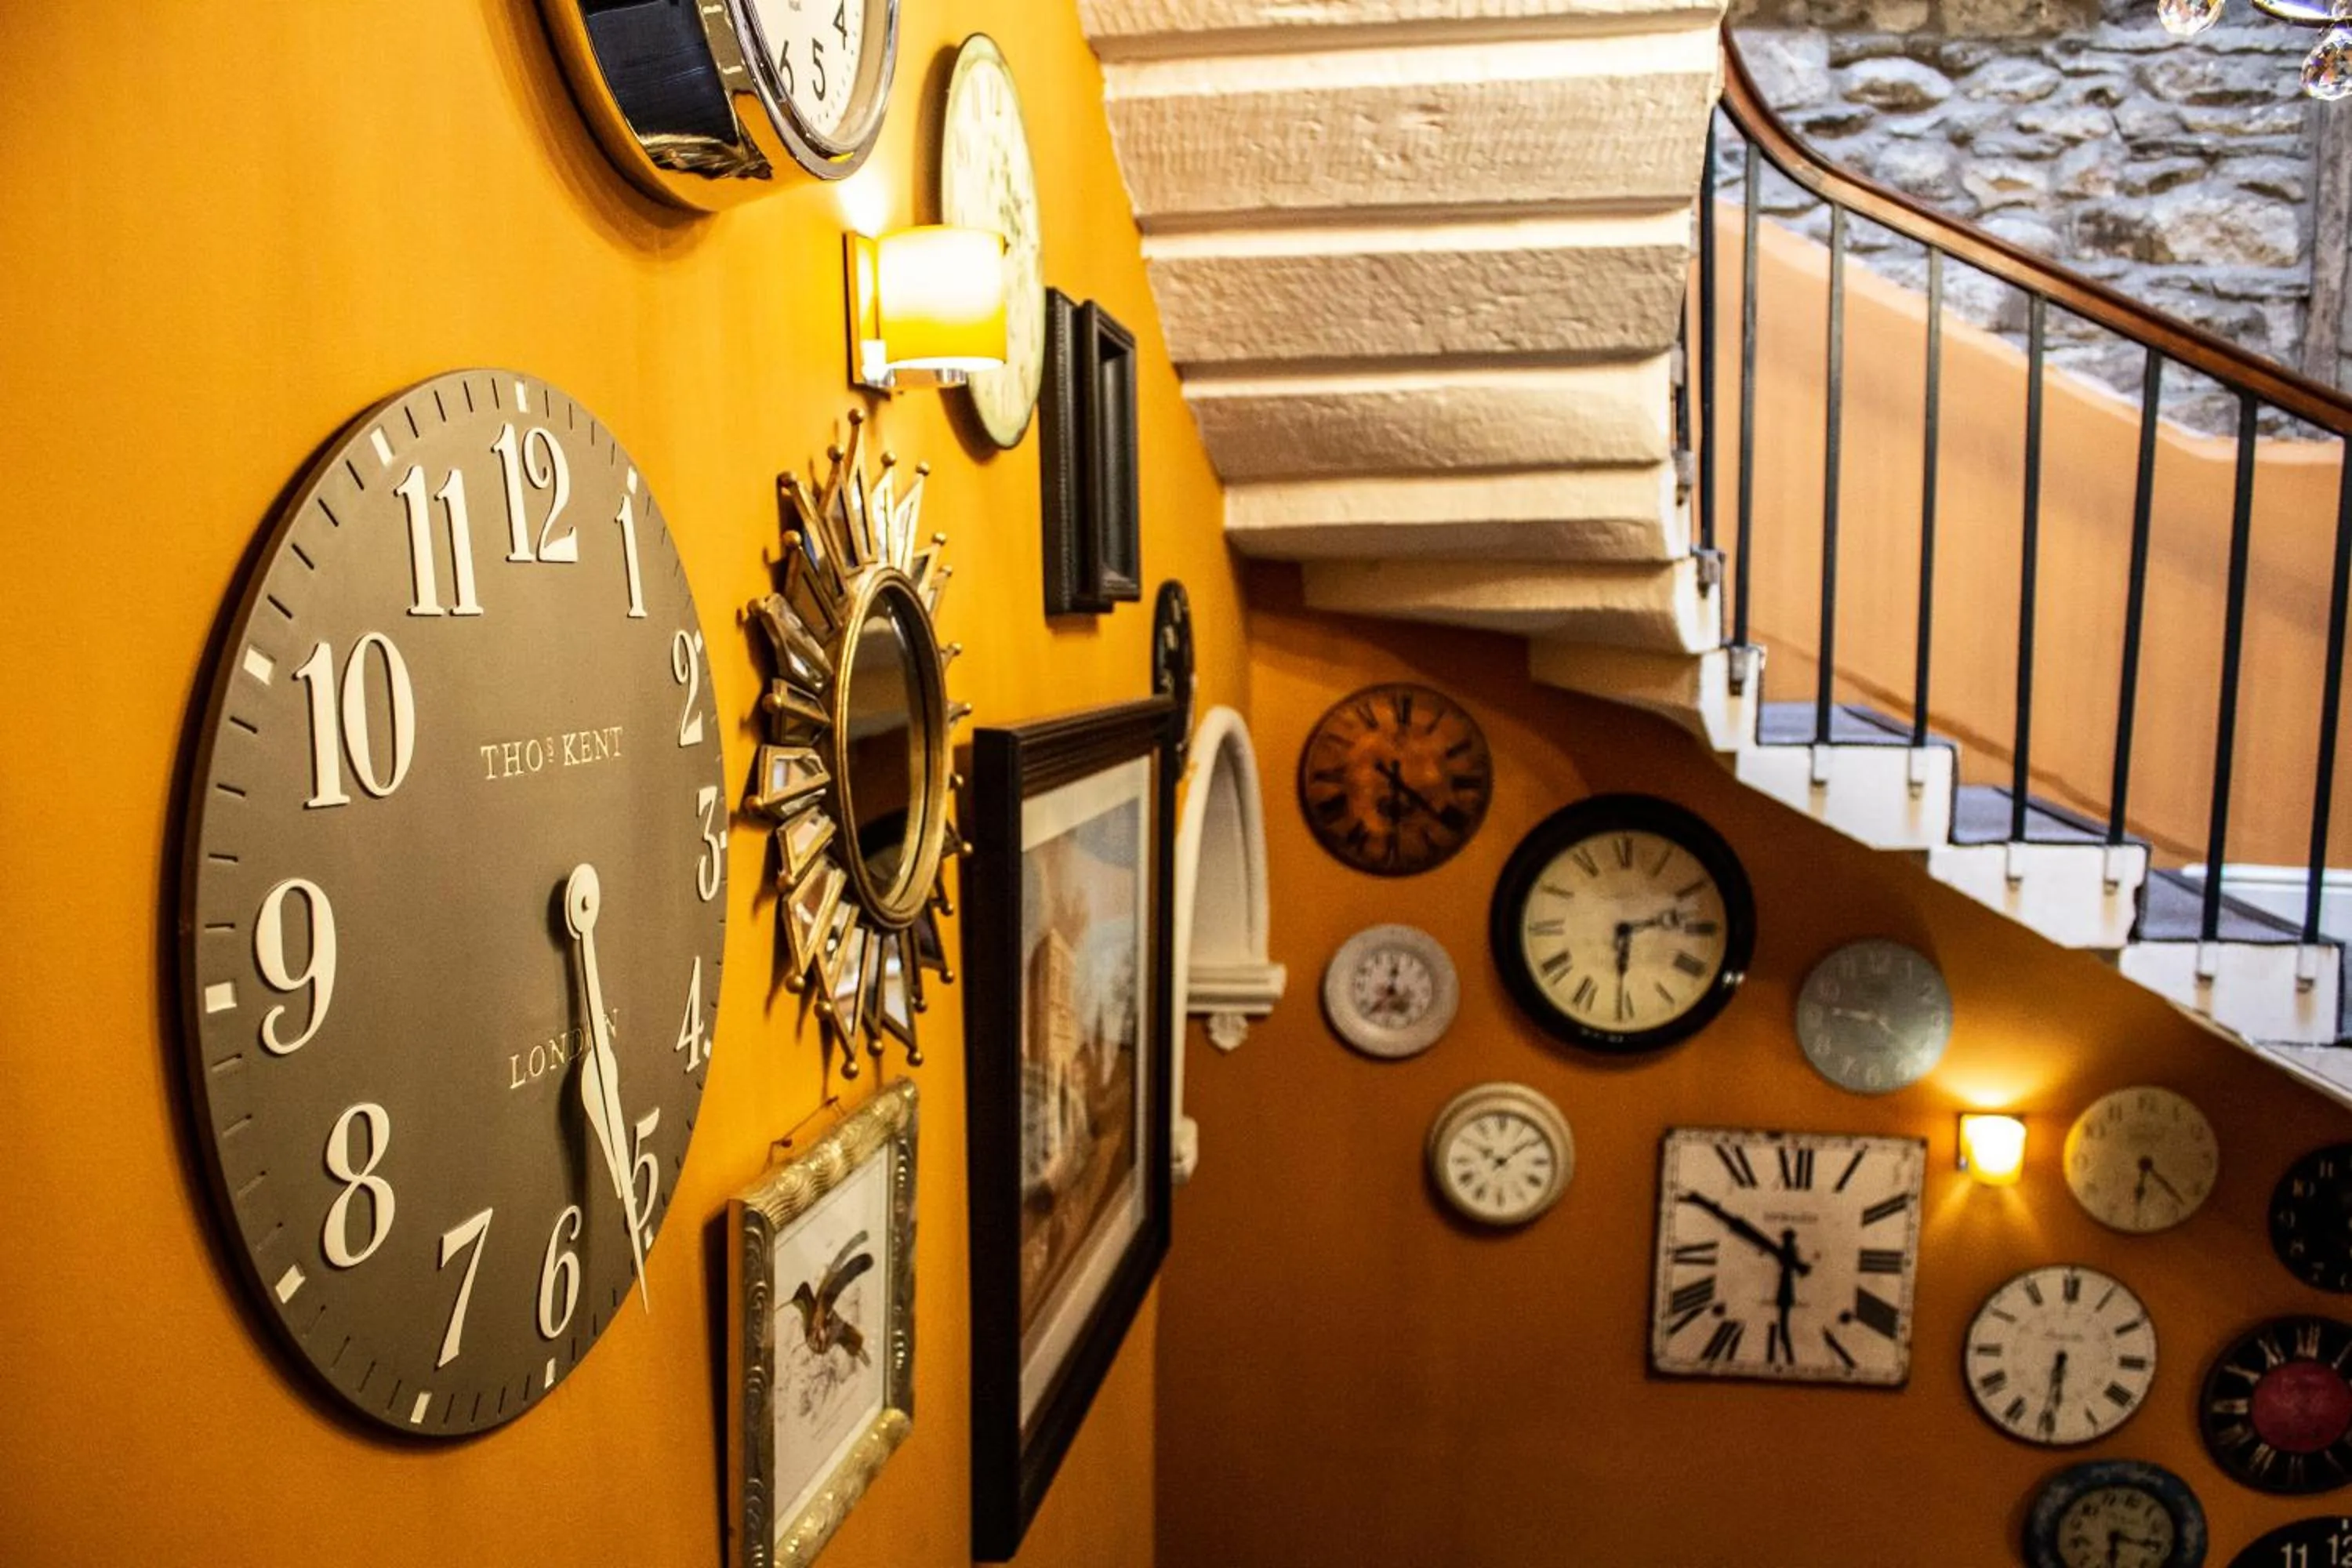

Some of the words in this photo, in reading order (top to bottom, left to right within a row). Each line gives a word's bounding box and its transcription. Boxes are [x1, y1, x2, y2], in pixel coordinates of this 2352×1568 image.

[812, 38, 826, 101] 5
[833, 0, 848, 50] 4
[394, 466, 484, 617] 11
[491, 423, 578, 563] 12
[615, 493, 647, 618] 1
[293, 632, 415, 808] 10
[562, 726, 622, 766] KENT
[673, 630, 702, 746] 2
[698, 786, 720, 902] 3
[255, 878, 336, 1054] 9
[675, 956, 706, 1073] 4
[510, 1008, 619, 1089] LONDN
[324, 1102, 395, 1268] 8
[633, 1107, 659, 1230] 5
[1778, 1145, 1815, 1191] XII
[436, 1208, 492, 1370] 7
[539, 1206, 582, 1339] 6
[2281, 1542, 2308, 1568] 11
